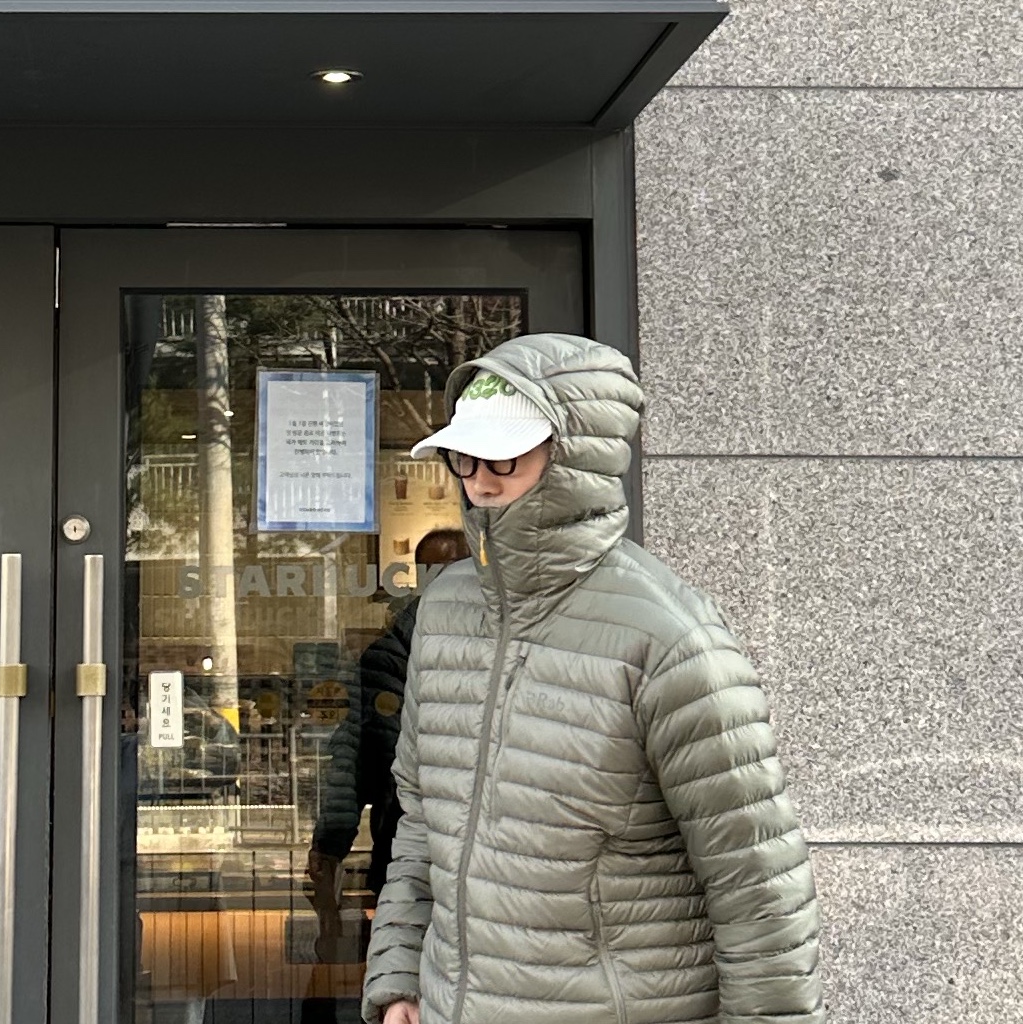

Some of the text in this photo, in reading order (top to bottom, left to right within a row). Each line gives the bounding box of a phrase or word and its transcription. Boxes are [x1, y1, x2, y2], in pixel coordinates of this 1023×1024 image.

[179, 563, 444, 598] STARBUCK
[161, 682, 171, 728] 당기세요
[536, 692, 566, 711] Rab
